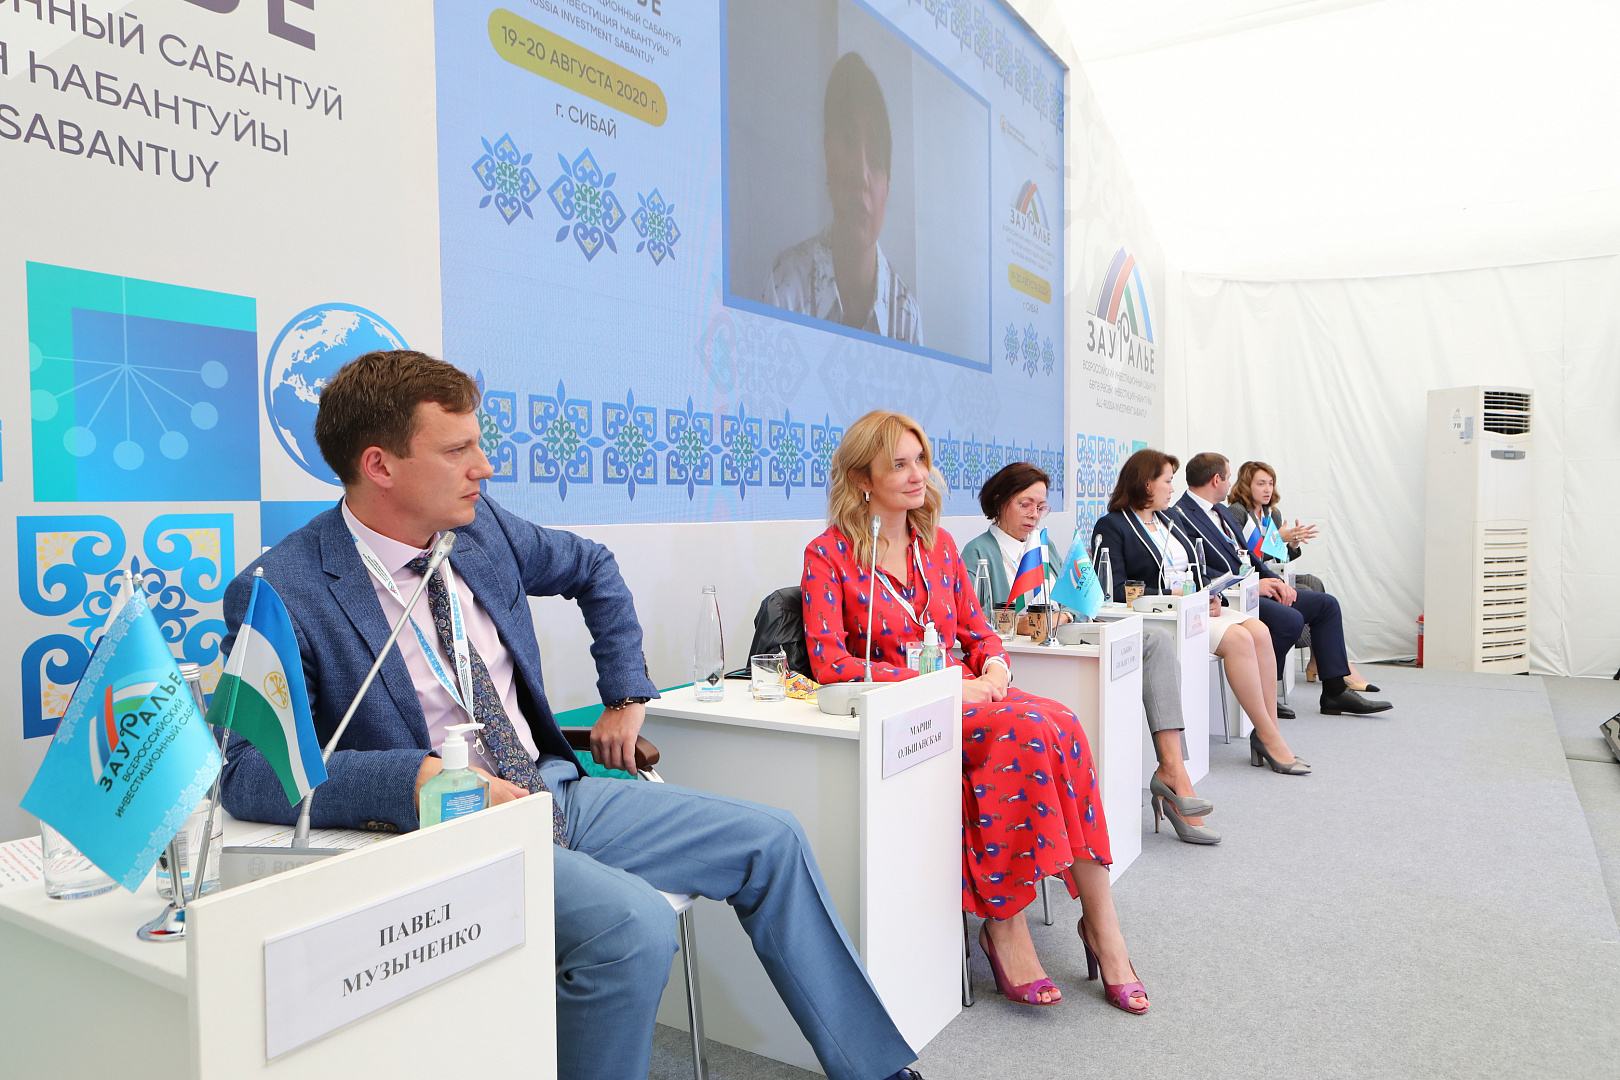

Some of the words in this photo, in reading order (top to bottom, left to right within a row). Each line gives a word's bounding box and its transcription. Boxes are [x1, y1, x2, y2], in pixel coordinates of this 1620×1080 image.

[561, 9, 613, 44] INVESTMENT
[615, 37, 655, 65] SABANTUY
[642, 19, 682, 47] САБАНТУЙ
[158, 34, 343, 121] САБАНТУЙ
[501, 25, 546, 61] 19-20
[550, 50, 613, 92] АВГУСТА
[616, 80, 648, 108] 2020
[651, 101, 659, 113] г.
[0, 104, 219, 188] SABANTUY
[555, 104, 564, 118] г.
[568, 105, 618, 140] СИБАЙ
[1087, 312, 1155, 375] ЗАУРАЛЬЕ
[100, 672, 182, 793] ЗАУРАЛЬЕ
[122, 698, 185, 782] ВСЕРОССИЙСКИЙ
[897, 731, 942, 759] ОЛЬШАНСКАЯ
[909, 719, 932, 737] МАРИЯ
[115, 724, 182, 819] ИНВЕСТИЦИОННЫЙ
[342, 922, 482, 998] МУЗЫЧЕНКО
[379, 903, 452, 948] ПАВЕЛ
